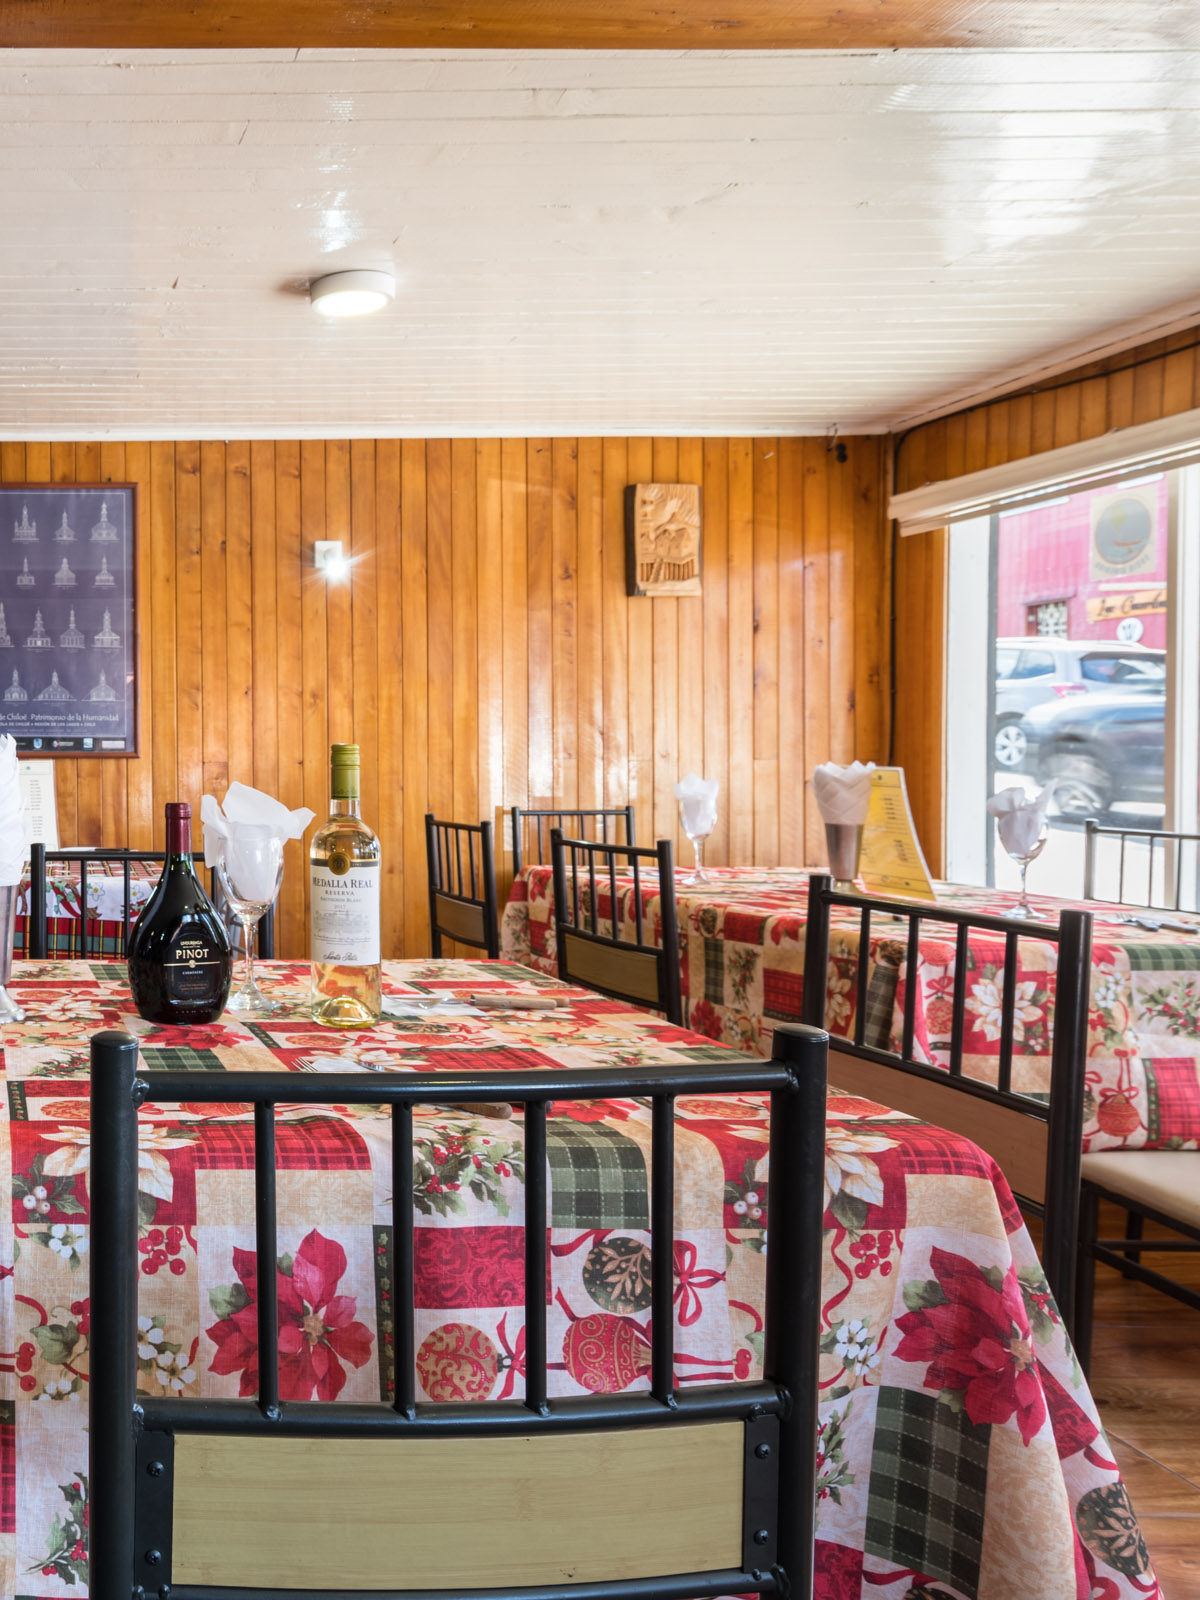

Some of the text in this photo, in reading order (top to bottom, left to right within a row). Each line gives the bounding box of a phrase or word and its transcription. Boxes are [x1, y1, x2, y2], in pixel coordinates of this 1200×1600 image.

[30, 713, 66, 721] Patrimonio
[67, 712, 75, 721] de
[76, 712, 82, 721] la
[83, 712, 119, 721] Humanidad
[312, 877, 374, 889] MEDALLA REAL
[175, 949, 209, 960] PINOT
